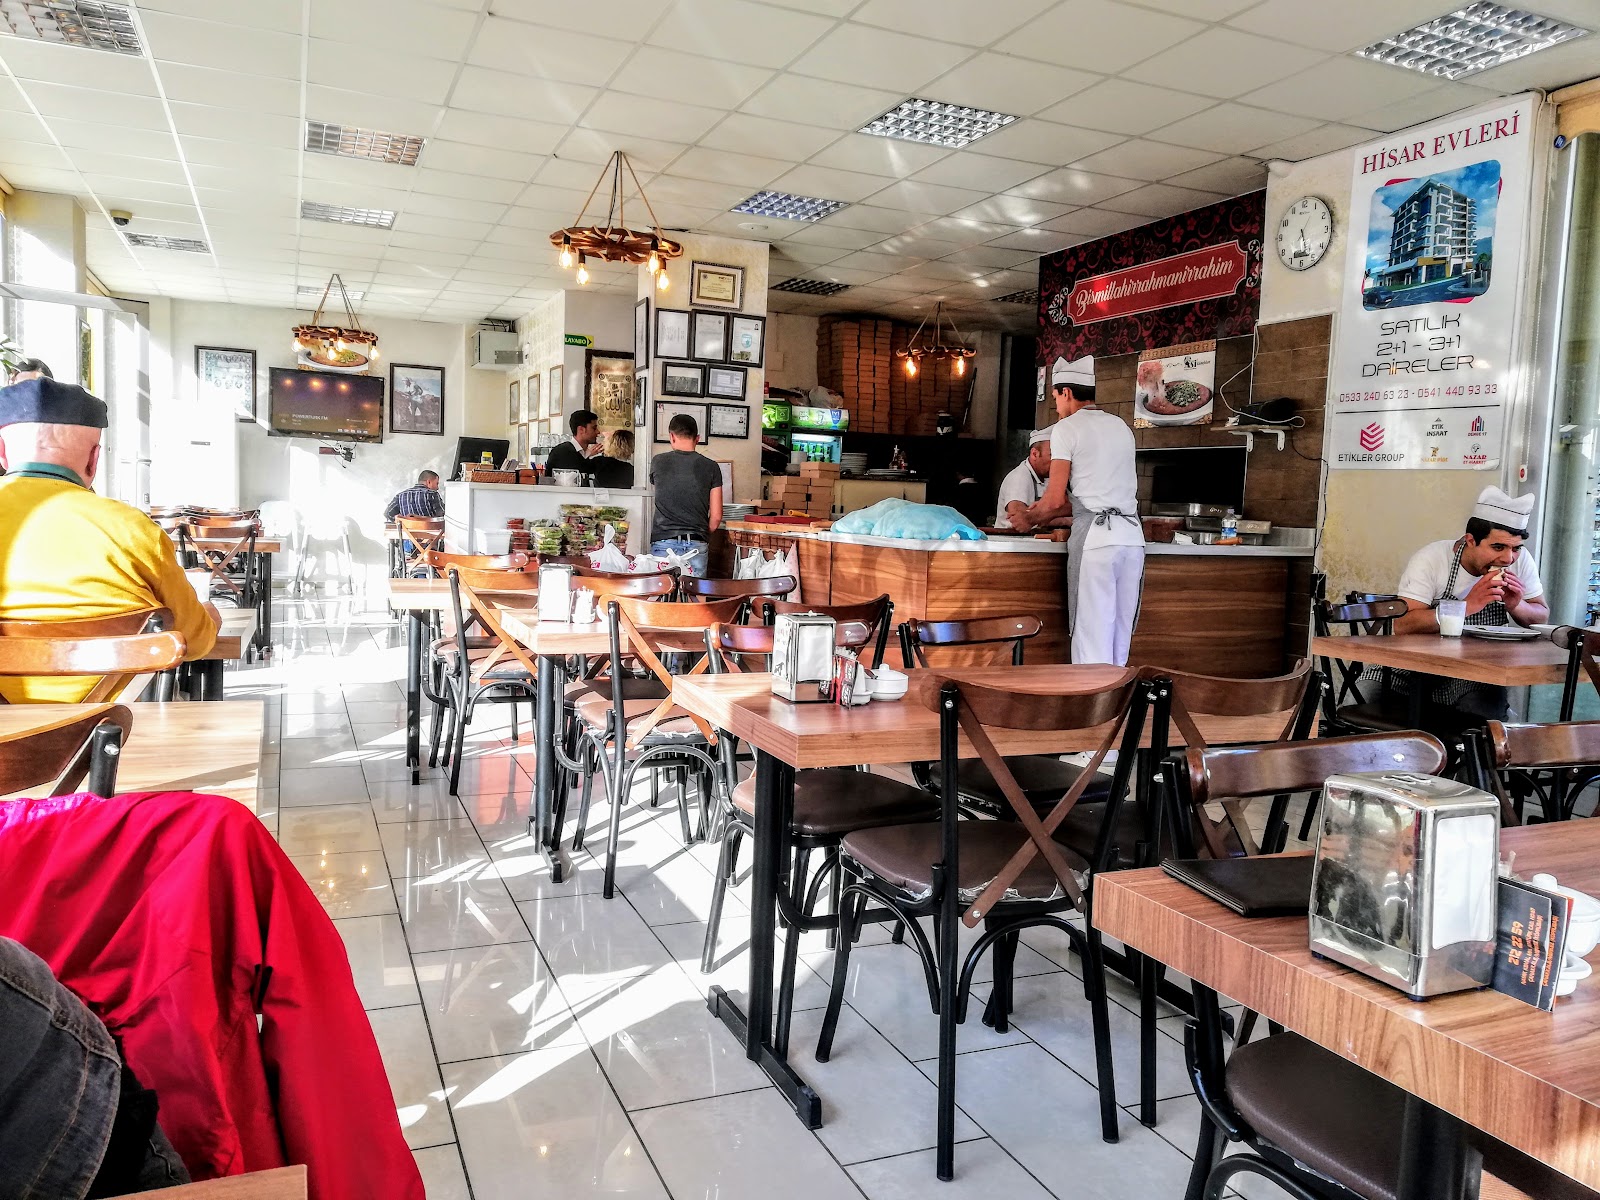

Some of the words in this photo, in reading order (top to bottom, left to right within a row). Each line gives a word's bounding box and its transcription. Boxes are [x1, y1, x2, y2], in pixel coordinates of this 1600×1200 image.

[1361, 141, 1426, 174] HİSAR
[1432, 110, 1520, 155] EVLERİ
[1076, 257, 1234, 316] Bismillahirrahmanirrahim
[1381, 313, 1461, 336] SATILIK
[1377, 341, 1406, 356] 2+1
[1429, 335, 1461, 351] 3+1
[1362, 355, 1474, 377] DAİRELER
[1339, 393, 1361, 402] 0533
[1364, 391, 1380, 401] 240
[1384, 390, 1394, 400] 63
[1398, 390, 1409, 399] 23
[1417, 387, 1441, 398] 0541
[1445, 386, 1464, 396] 440
[1468, 384, 1481, 395] 93
[1484, 384, 1498, 394] 33
[1338, 451, 1373, 462] ETİKLER
[1374, 453, 1405, 462] GROUP
[1511, 921, 1523, 935] 59
[1511, 935, 1523, 949] 22
[1508, 949, 1522, 965] 212
